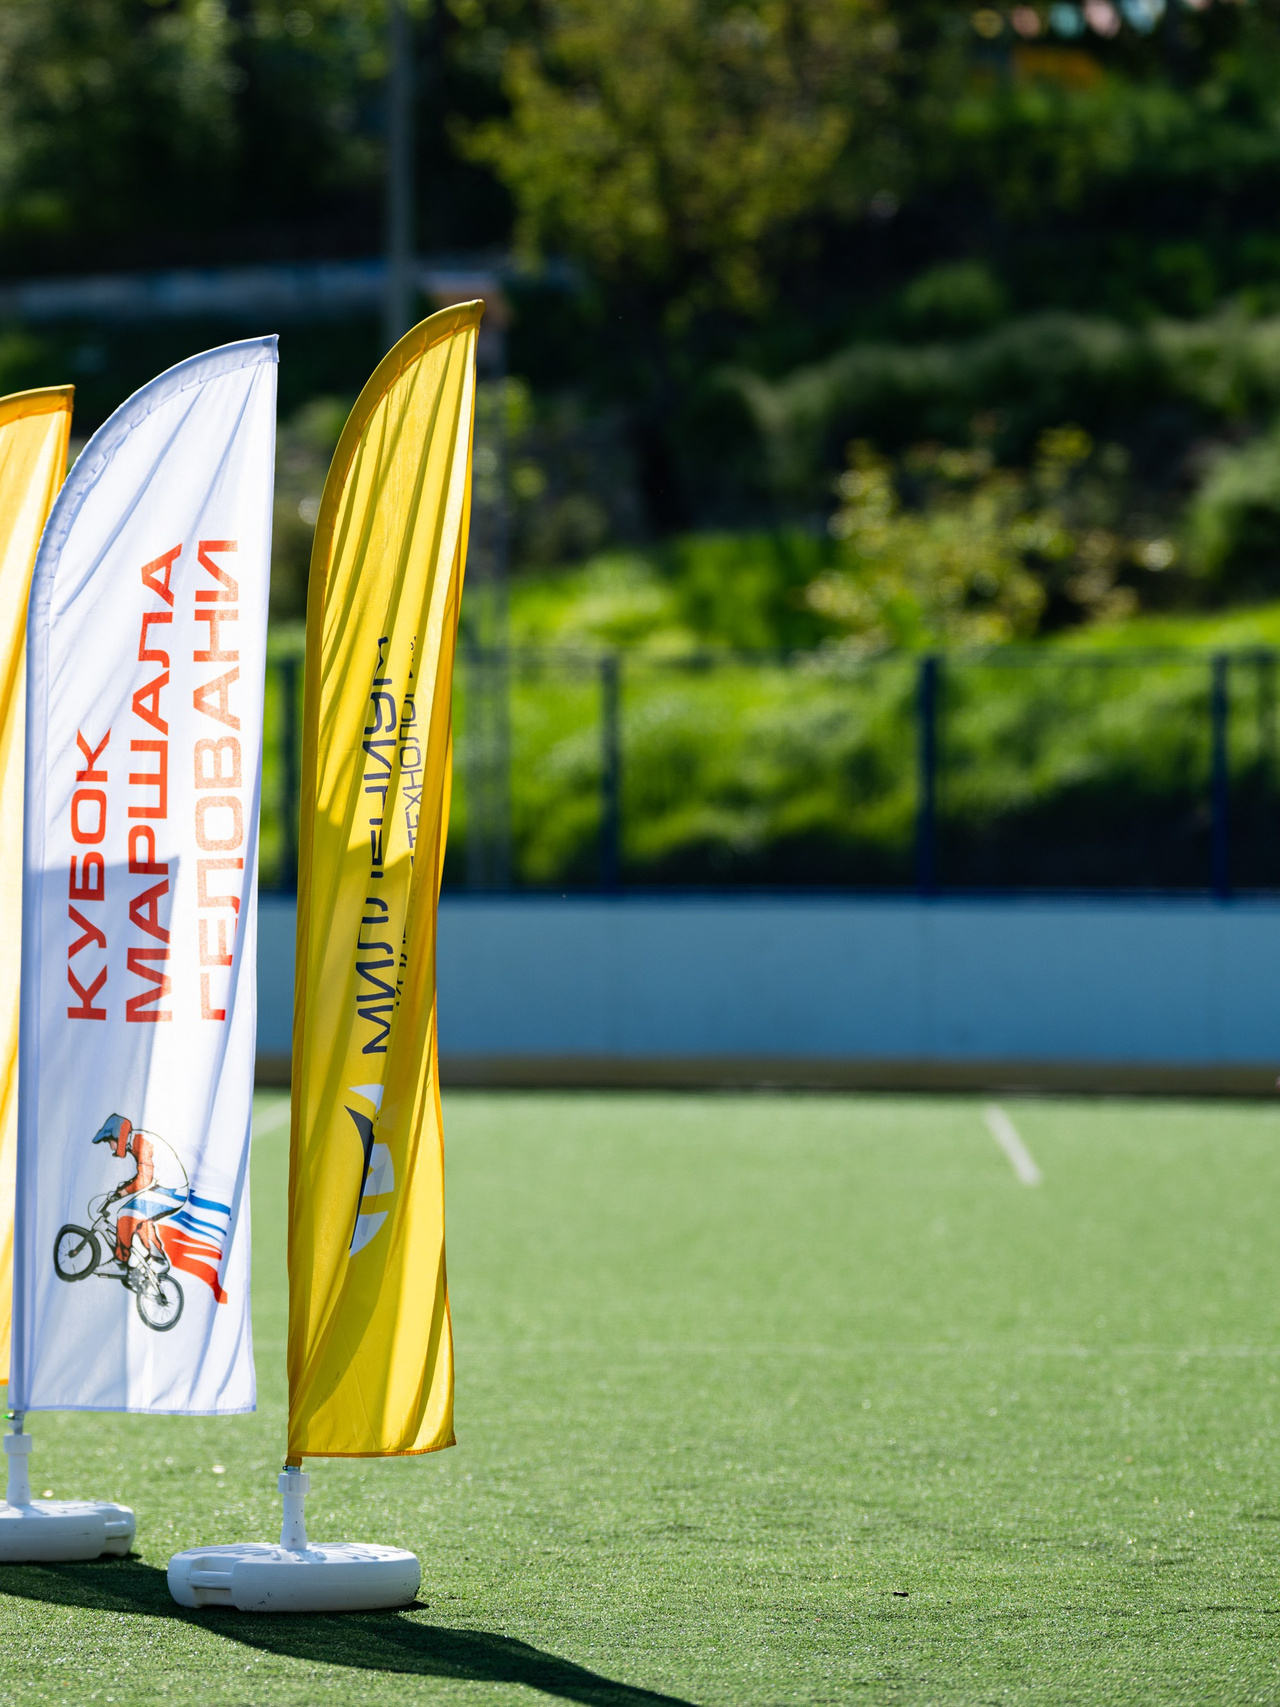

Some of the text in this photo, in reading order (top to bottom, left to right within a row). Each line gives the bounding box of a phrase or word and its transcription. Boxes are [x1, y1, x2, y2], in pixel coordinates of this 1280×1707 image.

[67, 727, 112, 1021] КУБОК
[125, 543, 183, 1023] МАРШАЛА
[192, 540, 244, 1022] ГЕЛОВАНИ
